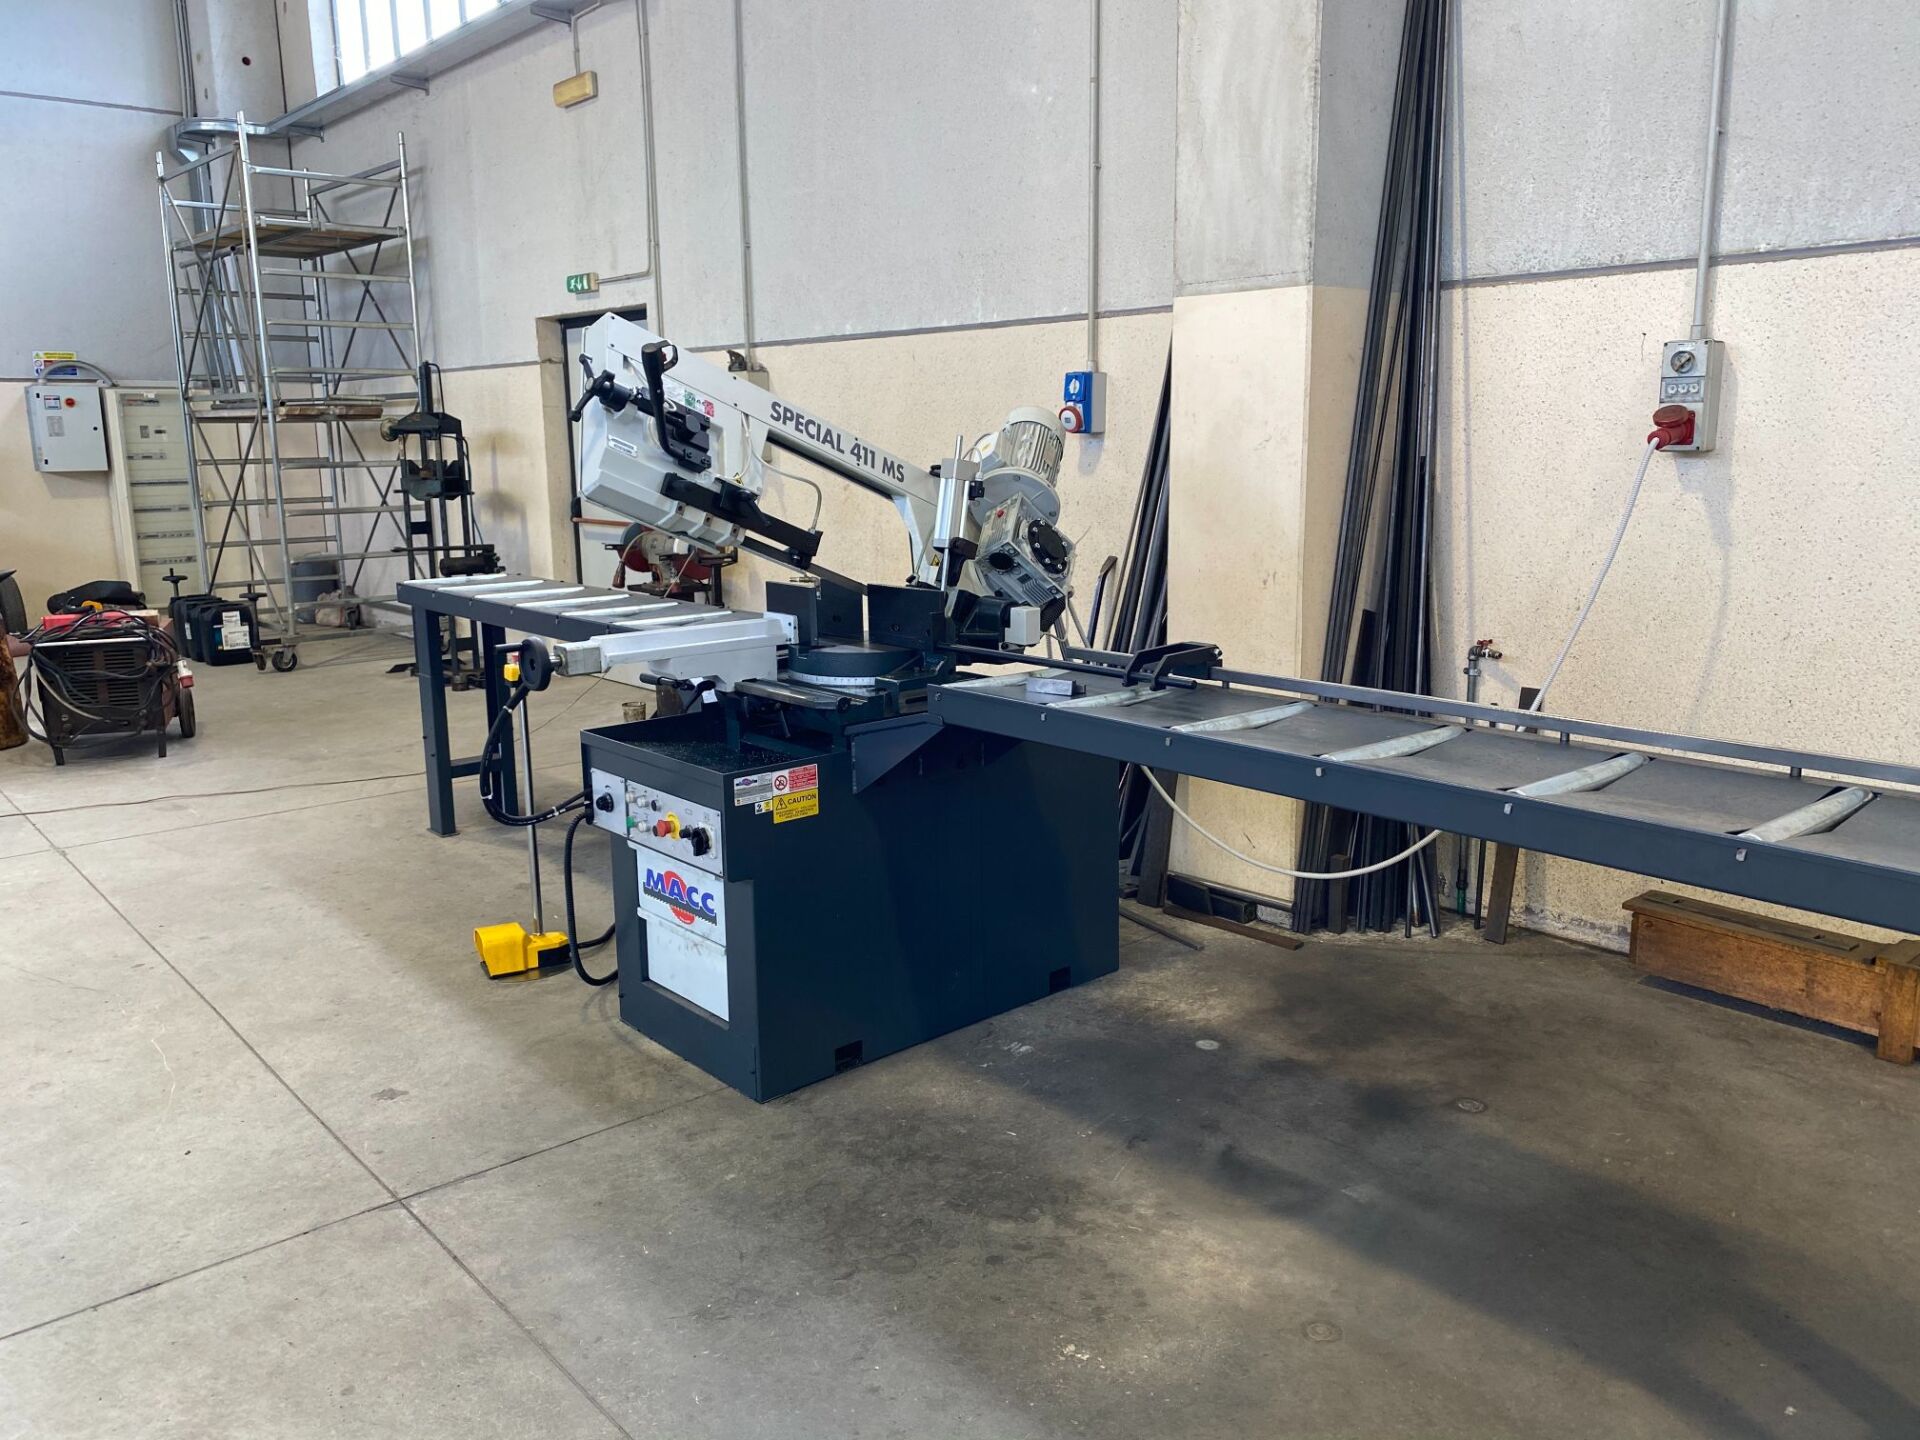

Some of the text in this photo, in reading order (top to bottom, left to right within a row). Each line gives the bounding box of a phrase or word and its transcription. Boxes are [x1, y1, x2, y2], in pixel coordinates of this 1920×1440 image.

[770, 401, 905, 483] SPECIAL 411 MS
[787, 793, 817, 805] CAUTION
[645, 868, 716, 915] MACC
